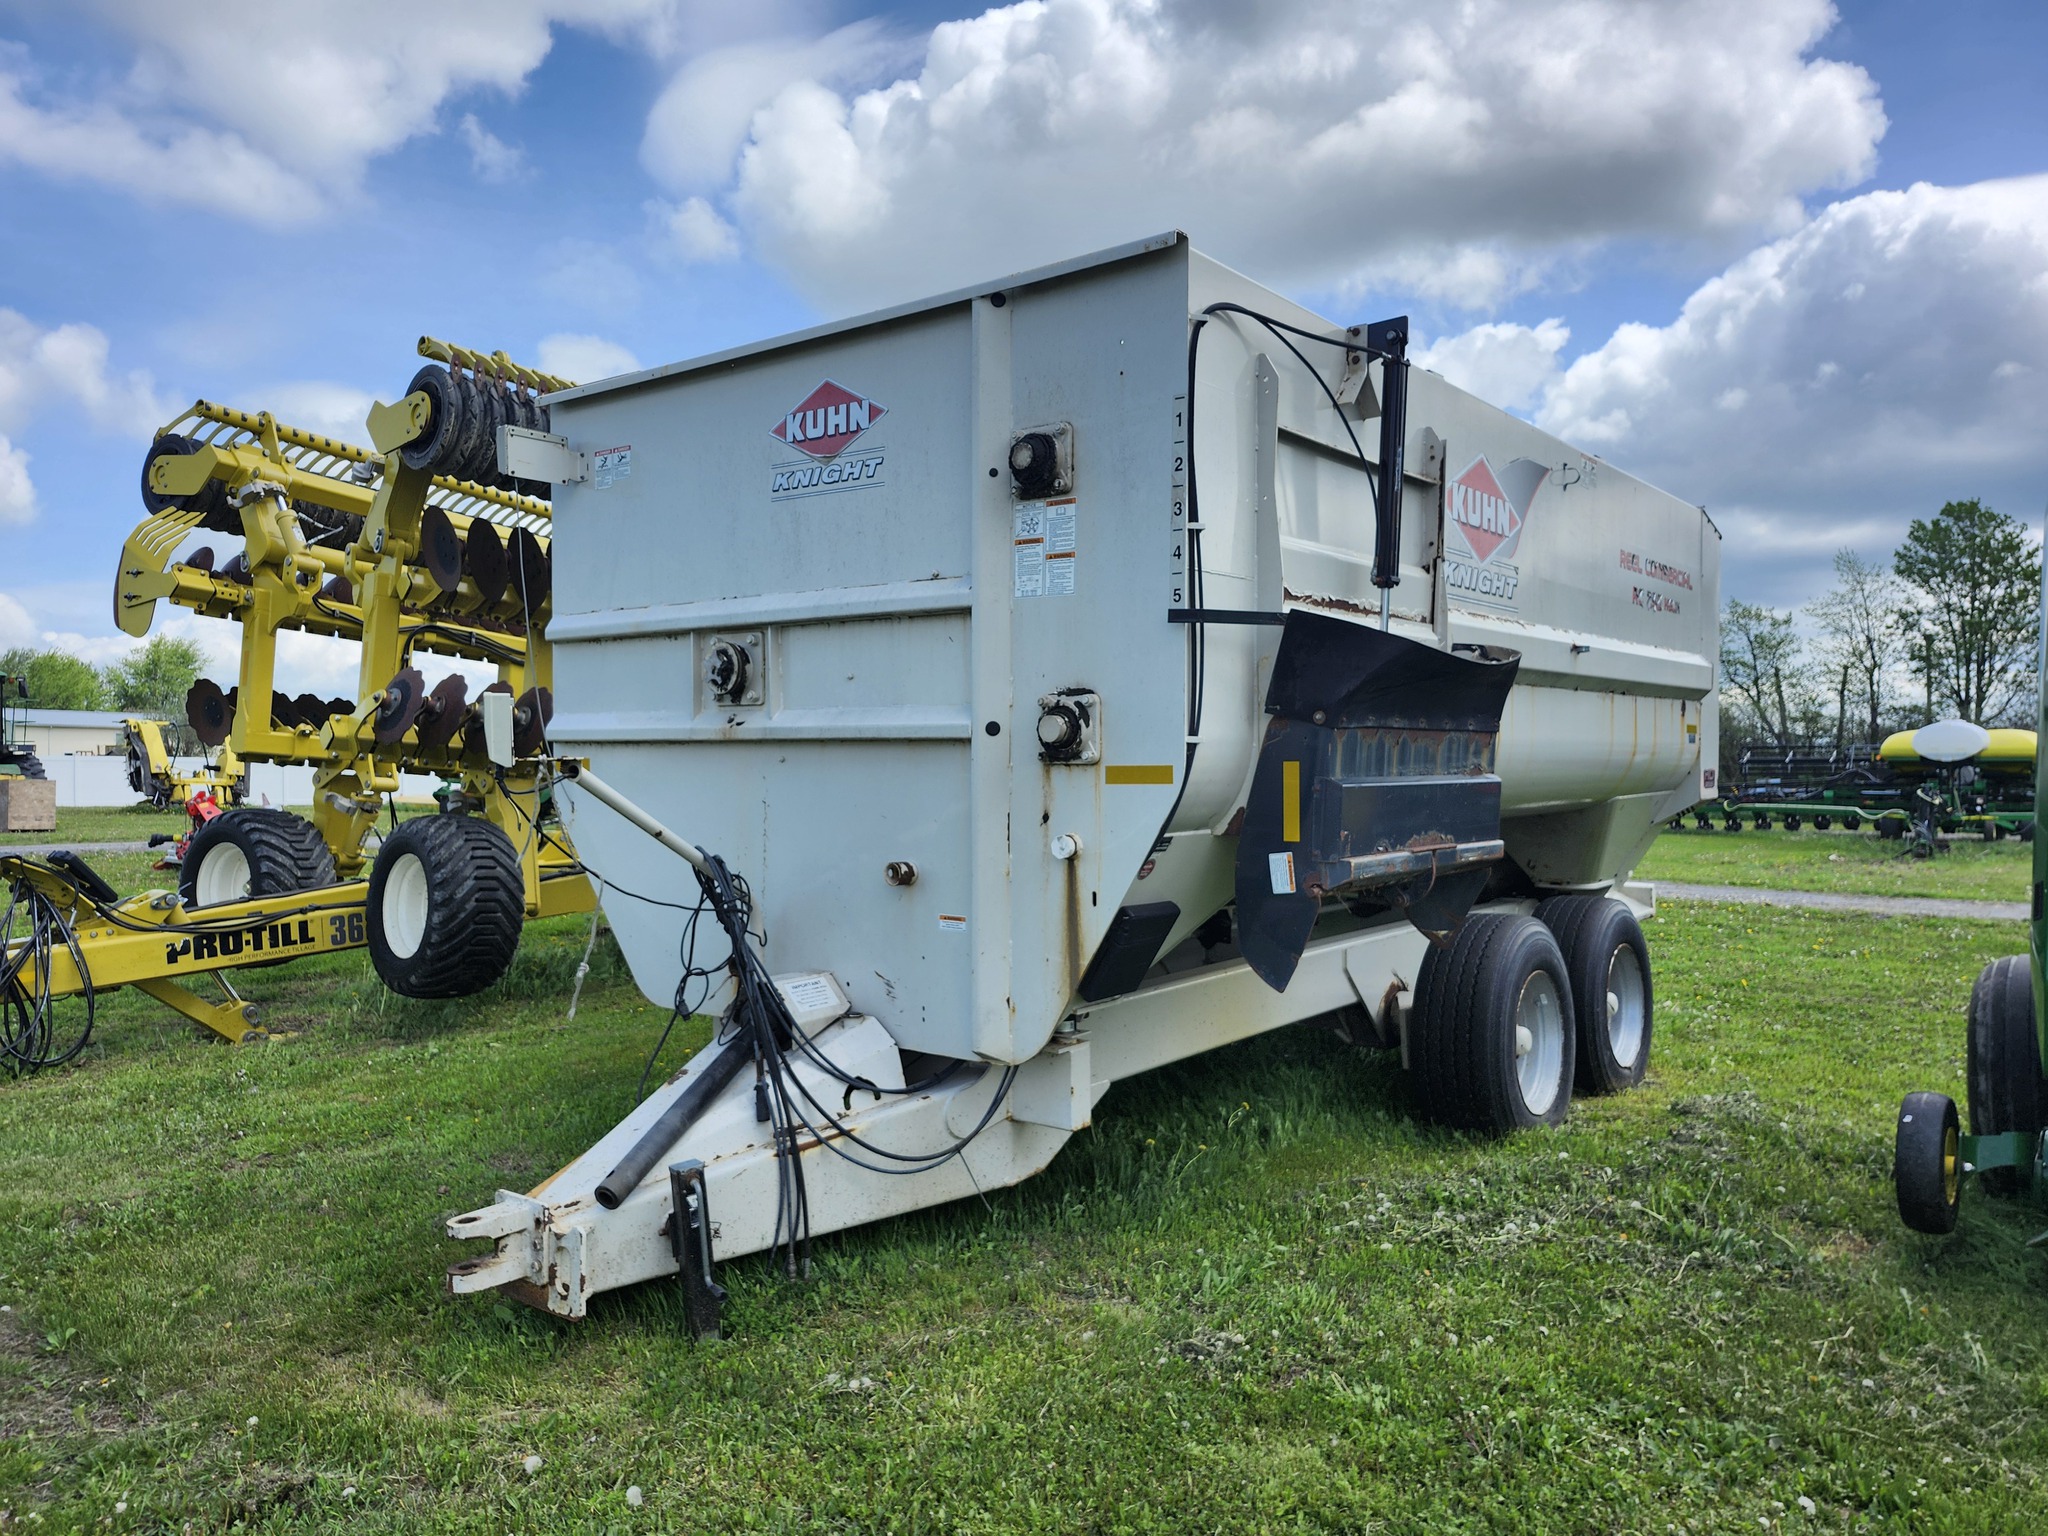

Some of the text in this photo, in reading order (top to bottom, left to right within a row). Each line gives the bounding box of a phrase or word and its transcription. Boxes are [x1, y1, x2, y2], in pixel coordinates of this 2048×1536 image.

[785, 399, 871, 444] KUHN
[1175, 411, 1182, 426] 1
[1174, 457, 1183, 472] 2
[772, 457, 884, 492] KNIGHT
[1174, 502, 1183, 516] 3
[1452, 481, 1511, 538] KUHN
[1173, 546, 1182, 560] 4
[1444, 560, 1518, 600] KNIGHT
[1173, 588, 1182, 603] 5
[244, 948, 292, 961] PERFORMANCE
[292, 944, 316, 953] TILLAGE
